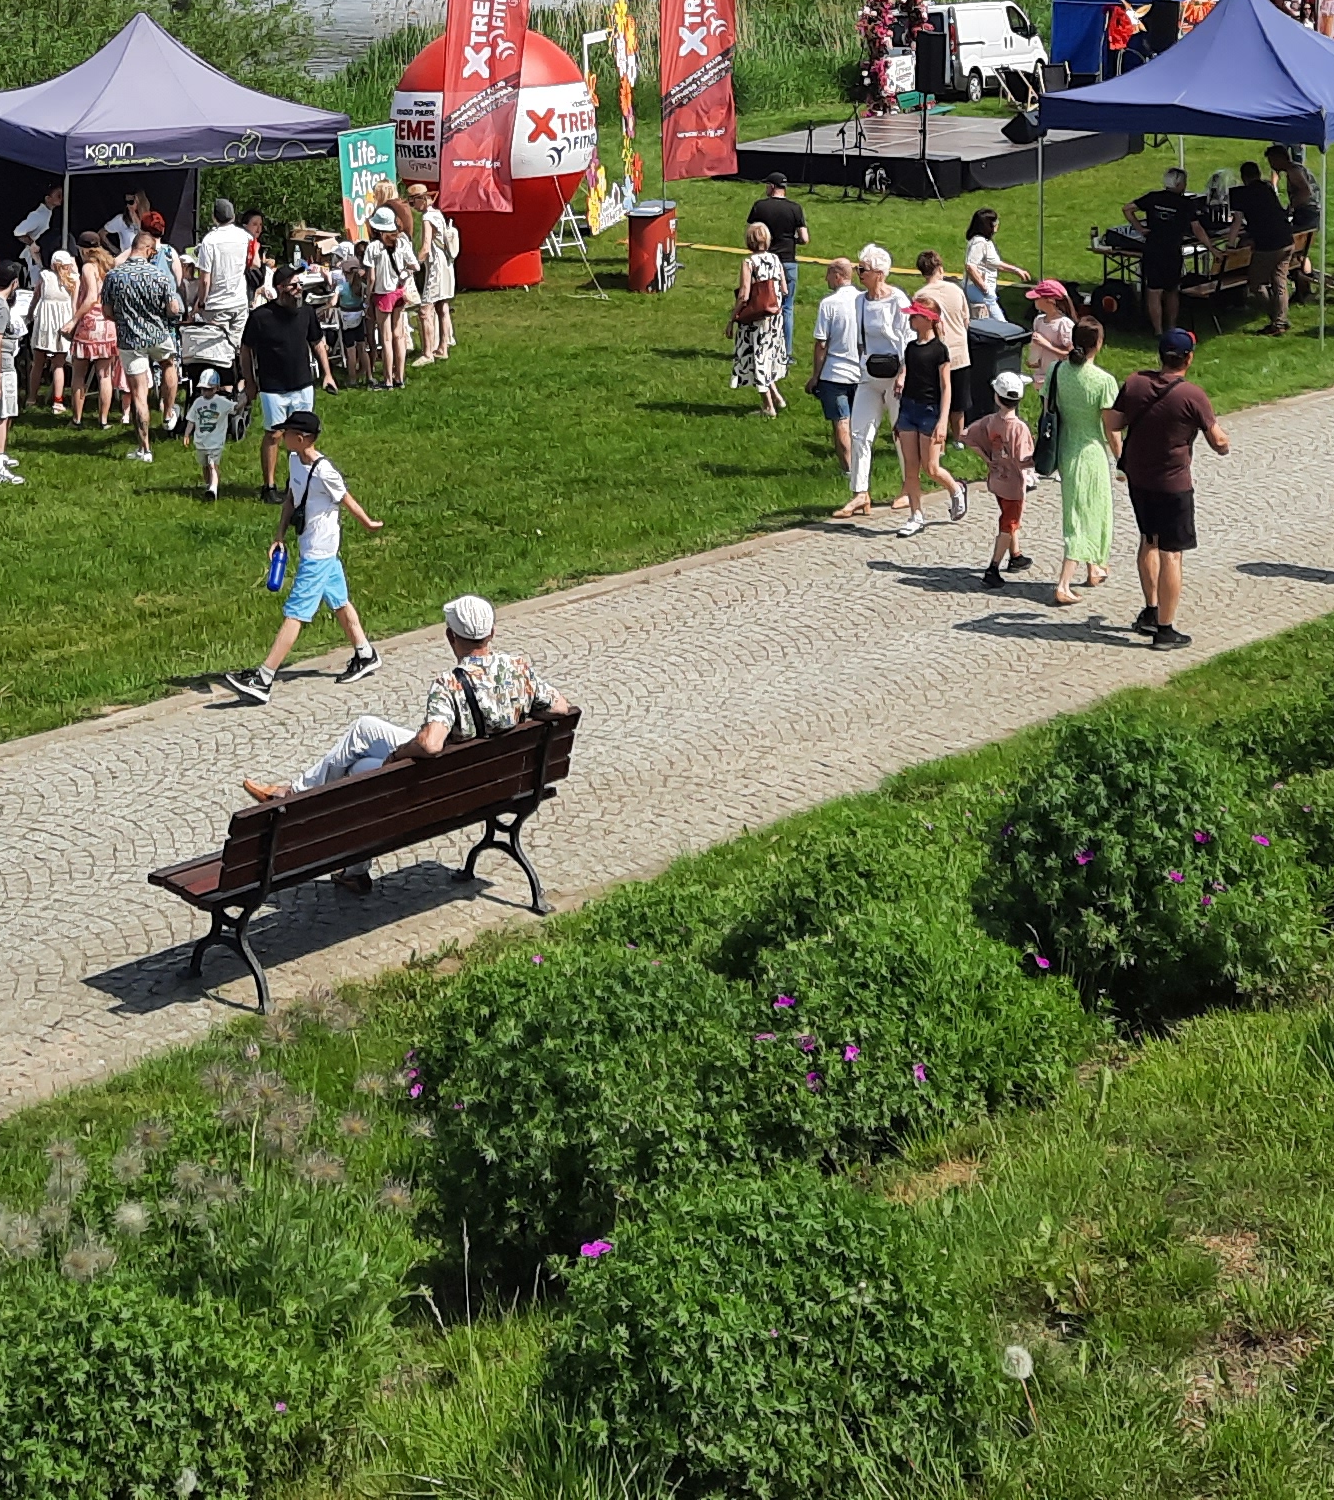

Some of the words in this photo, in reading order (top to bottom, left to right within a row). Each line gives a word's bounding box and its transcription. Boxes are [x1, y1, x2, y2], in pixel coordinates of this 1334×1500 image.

[396, 120, 436, 141] EME
[526, 107, 597, 144] XTREM
[348, 140, 376, 168] Life
[396, 143, 437, 159] FITNESS
